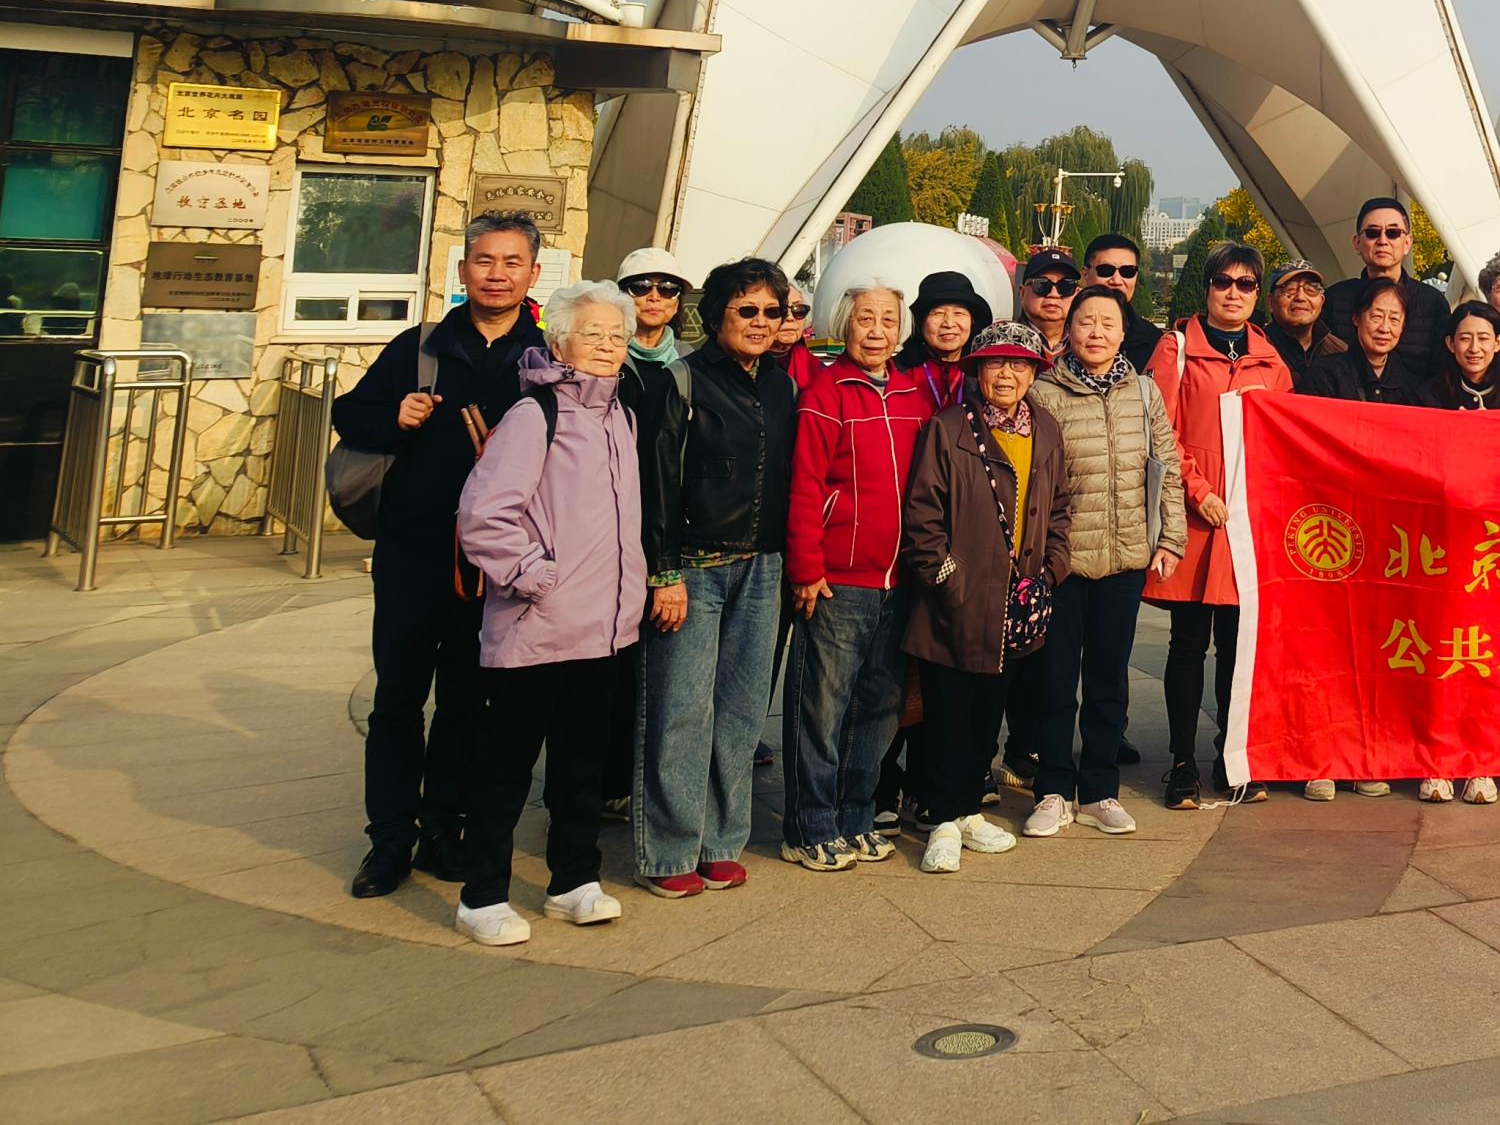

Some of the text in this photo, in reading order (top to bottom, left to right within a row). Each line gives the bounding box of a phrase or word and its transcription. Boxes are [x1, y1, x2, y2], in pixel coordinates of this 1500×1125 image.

[177, 106, 268, 121] 北京名园
[177, 195, 247, 210] 教育基地
